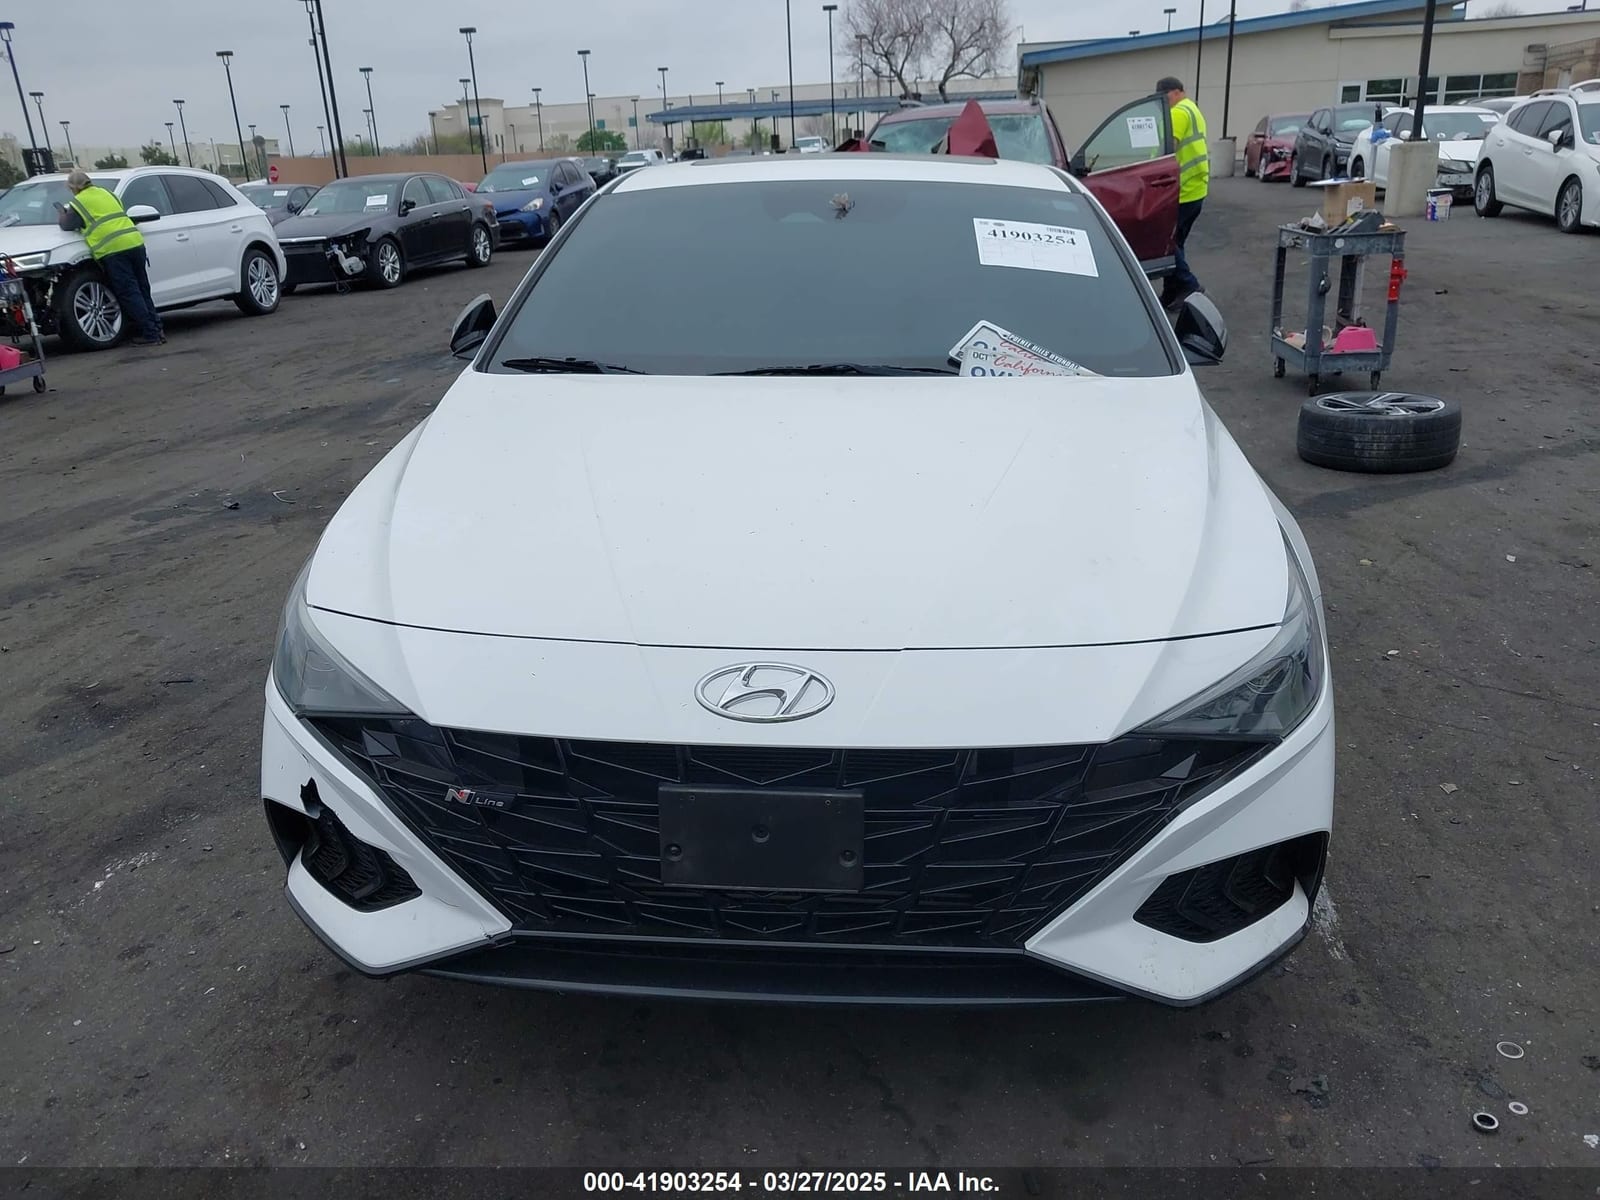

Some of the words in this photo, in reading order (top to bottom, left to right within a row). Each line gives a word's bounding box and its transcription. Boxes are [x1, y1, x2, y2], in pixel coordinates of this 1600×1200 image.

[988, 229, 1076, 246] 41903254
[972, 351, 989, 361] OCT
[1031, 344, 1050, 357] HILLS
[475, 797, 505, 807] Line
